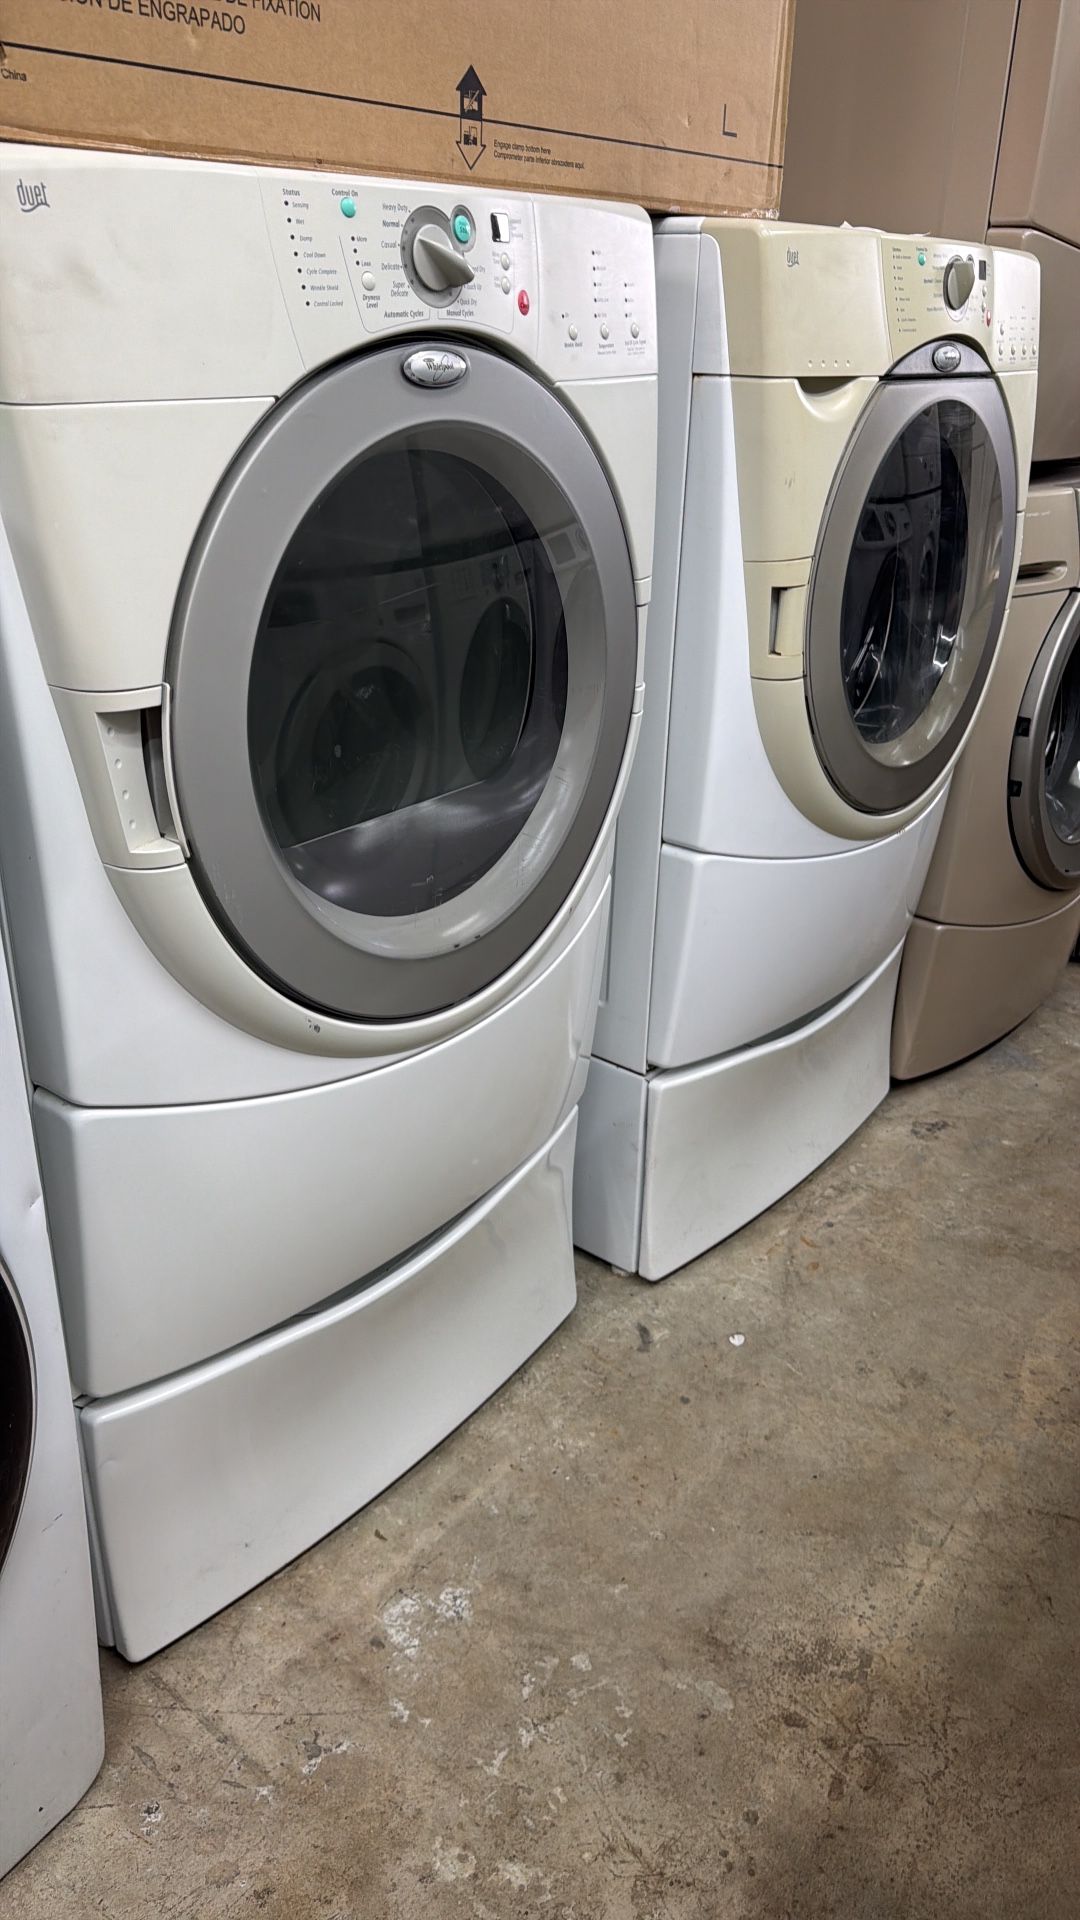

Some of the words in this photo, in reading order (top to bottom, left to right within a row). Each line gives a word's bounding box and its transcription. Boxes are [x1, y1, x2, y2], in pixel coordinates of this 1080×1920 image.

[138, 1, 246, 35] ENGRAPADO
[1, 68, 27, 82] China
[493, 139, 512, 151] Engage
[282, 188, 301, 197] Status
[331, 188, 351, 197] Control
[350, 190, 359, 198] On
[382, 219, 400, 228] Normal
[384, 310, 409, 318] Automatic
[409, 309, 424, 320] Cycles
